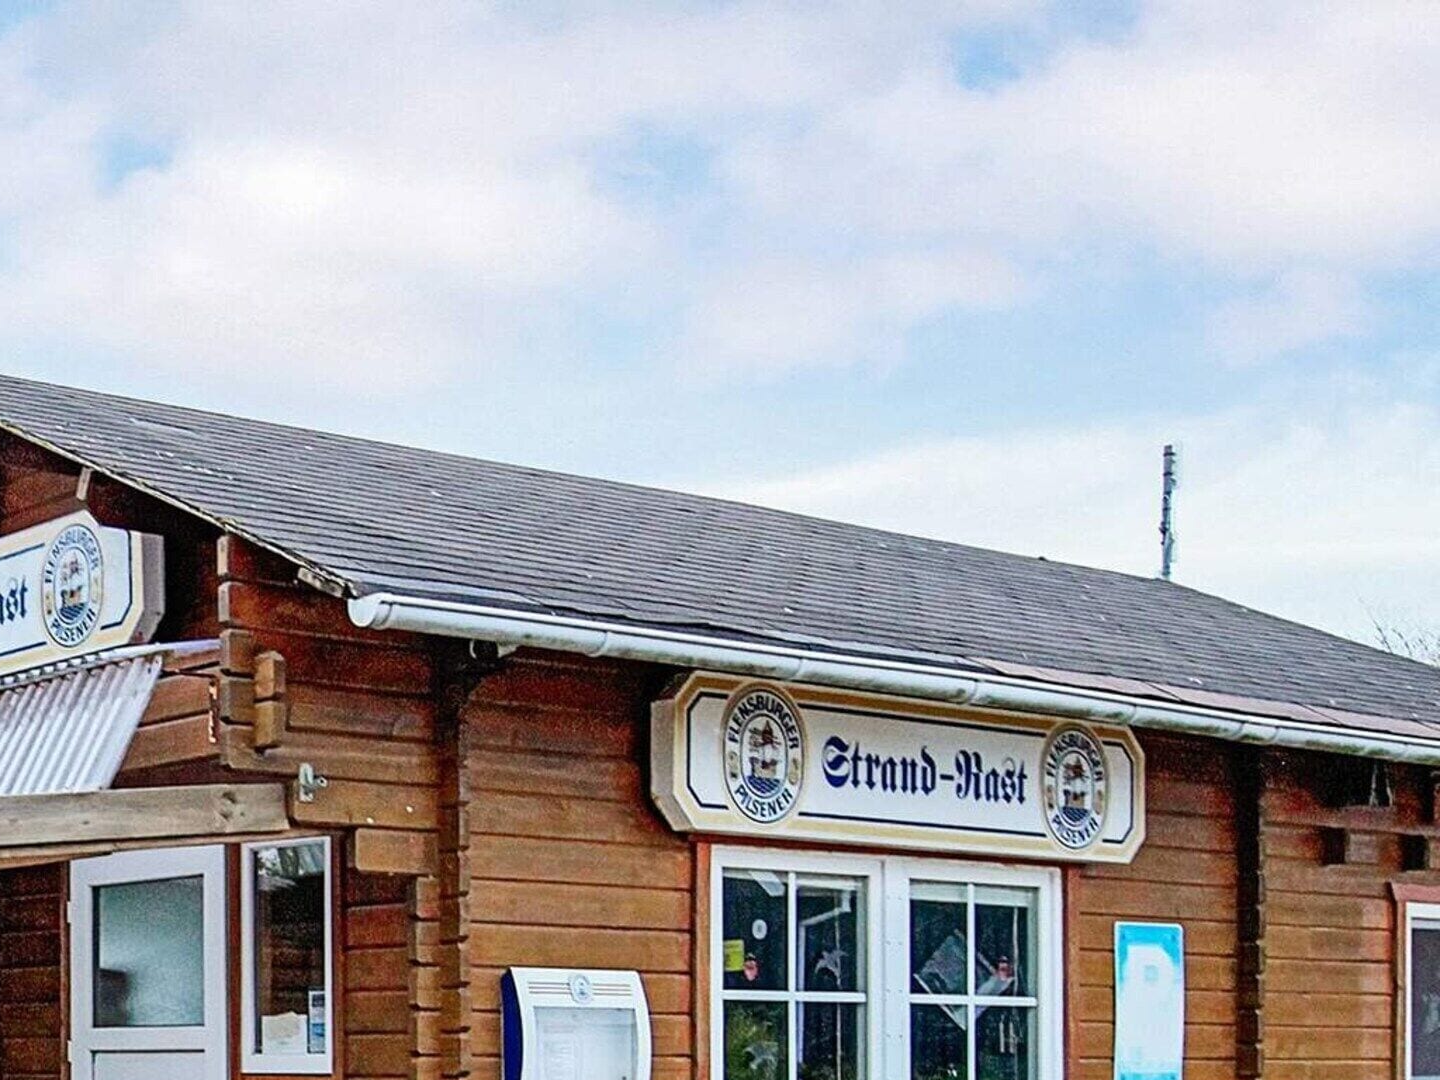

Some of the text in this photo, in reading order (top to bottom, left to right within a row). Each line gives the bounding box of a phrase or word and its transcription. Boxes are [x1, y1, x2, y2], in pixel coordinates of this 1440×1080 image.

[727, 694, 800, 750] FLENSBURGER
[822, 735, 1028, 804] Strand-Rast
[734, 784, 794, 817] PILSENER
